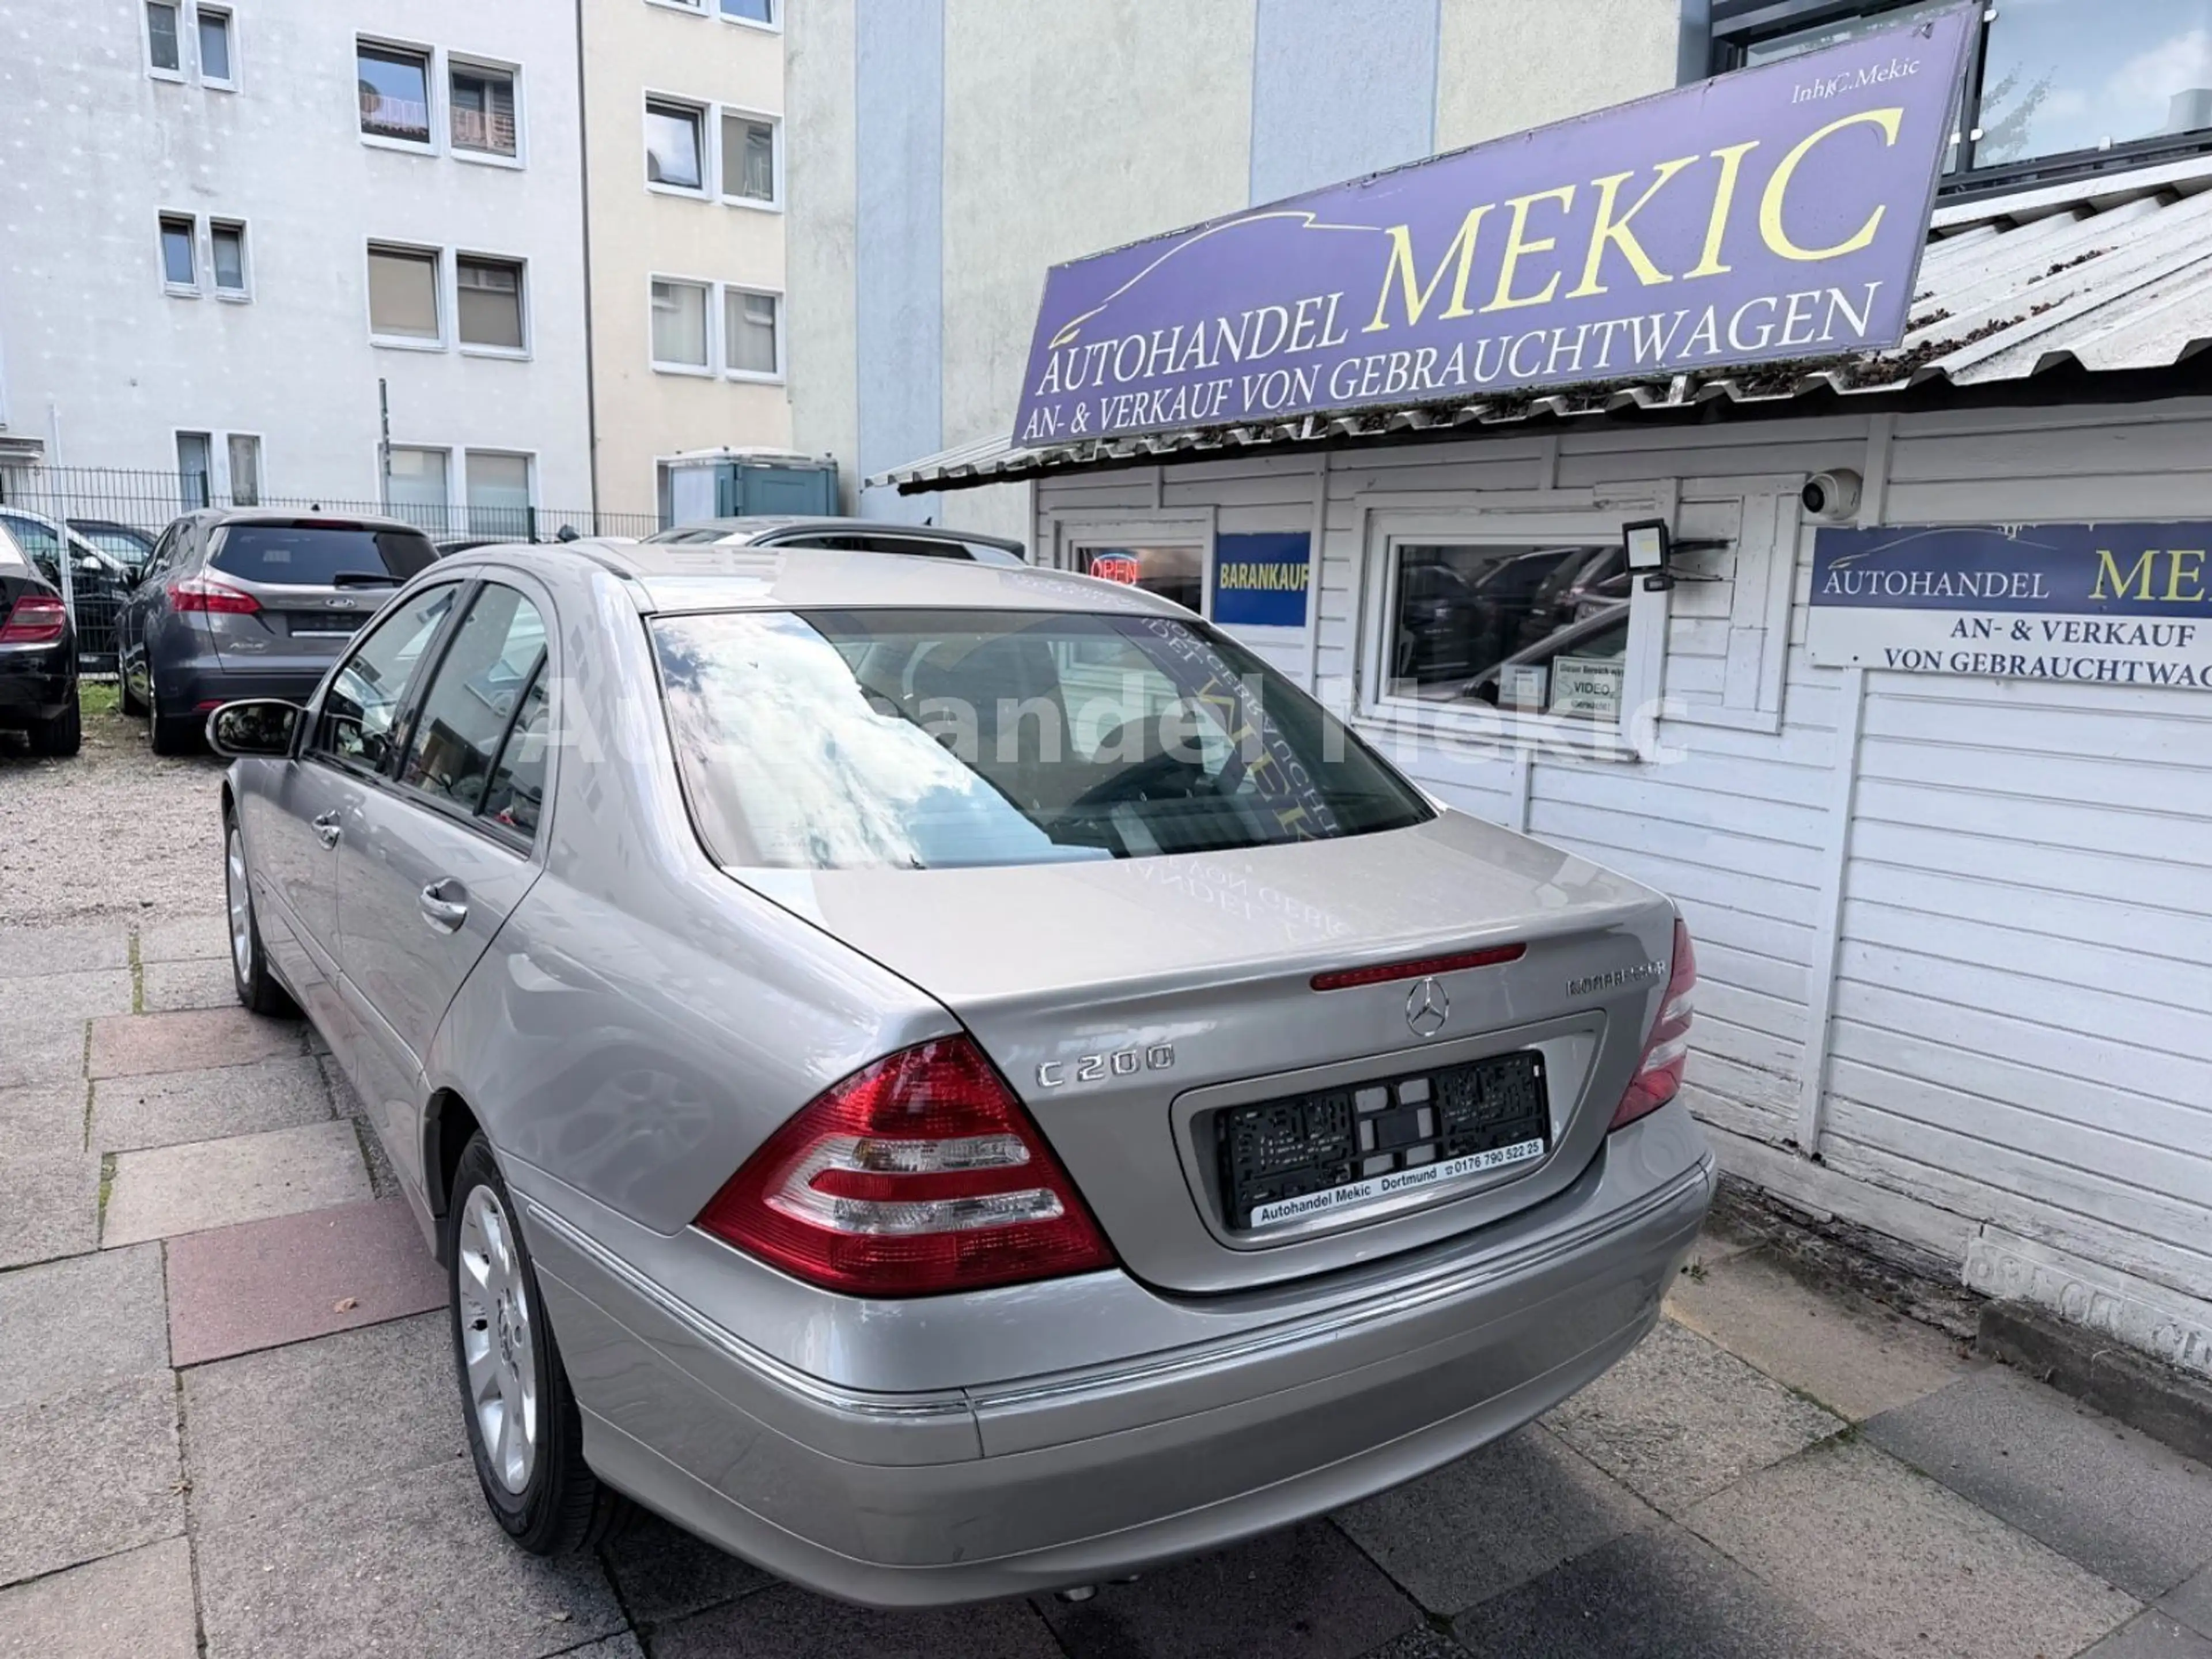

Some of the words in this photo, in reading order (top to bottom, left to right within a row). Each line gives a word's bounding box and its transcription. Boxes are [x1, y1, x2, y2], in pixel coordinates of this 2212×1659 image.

[1036, 291, 1349, 396] AUTOHANDEL
[1362, 108, 1903, 332] MEKIC
[1022, 404, 1065, 440] AN-
[1070, 402, 1092, 433] &
[1100, 378, 1232, 430] VERKAUF
[1241, 364, 1321, 412] VON
[1330, 281, 1883, 400] GEBRAUCHTWAGEN
[1219, 562, 1310, 592] BARANKAUF
[1822, 567, 2051, 599] AUTOHANDEL
[2088, 550, 2212, 602] ME
[1950, 617, 2003, 639] AN-
[2010, 619, 2033, 642] &
[2041, 620, 2196, 647] VERKAUF
[1884, 647, 1944, 671] VON
[1036, 1060, 1065, 1089] C
[1077, 1043, 1175, 1082] 200
[1260, 1192, 1332, 1221] Autohandel
[1336, 1184, 1372, 1203] Mekic
[1382, 1168, 1437, 1191] Dortmund
[1455, 1159, 1482, 1174] 0176
[1484, 1151, 1502, 1165] 790
[1527, 1142, 1540, 1155] 25
